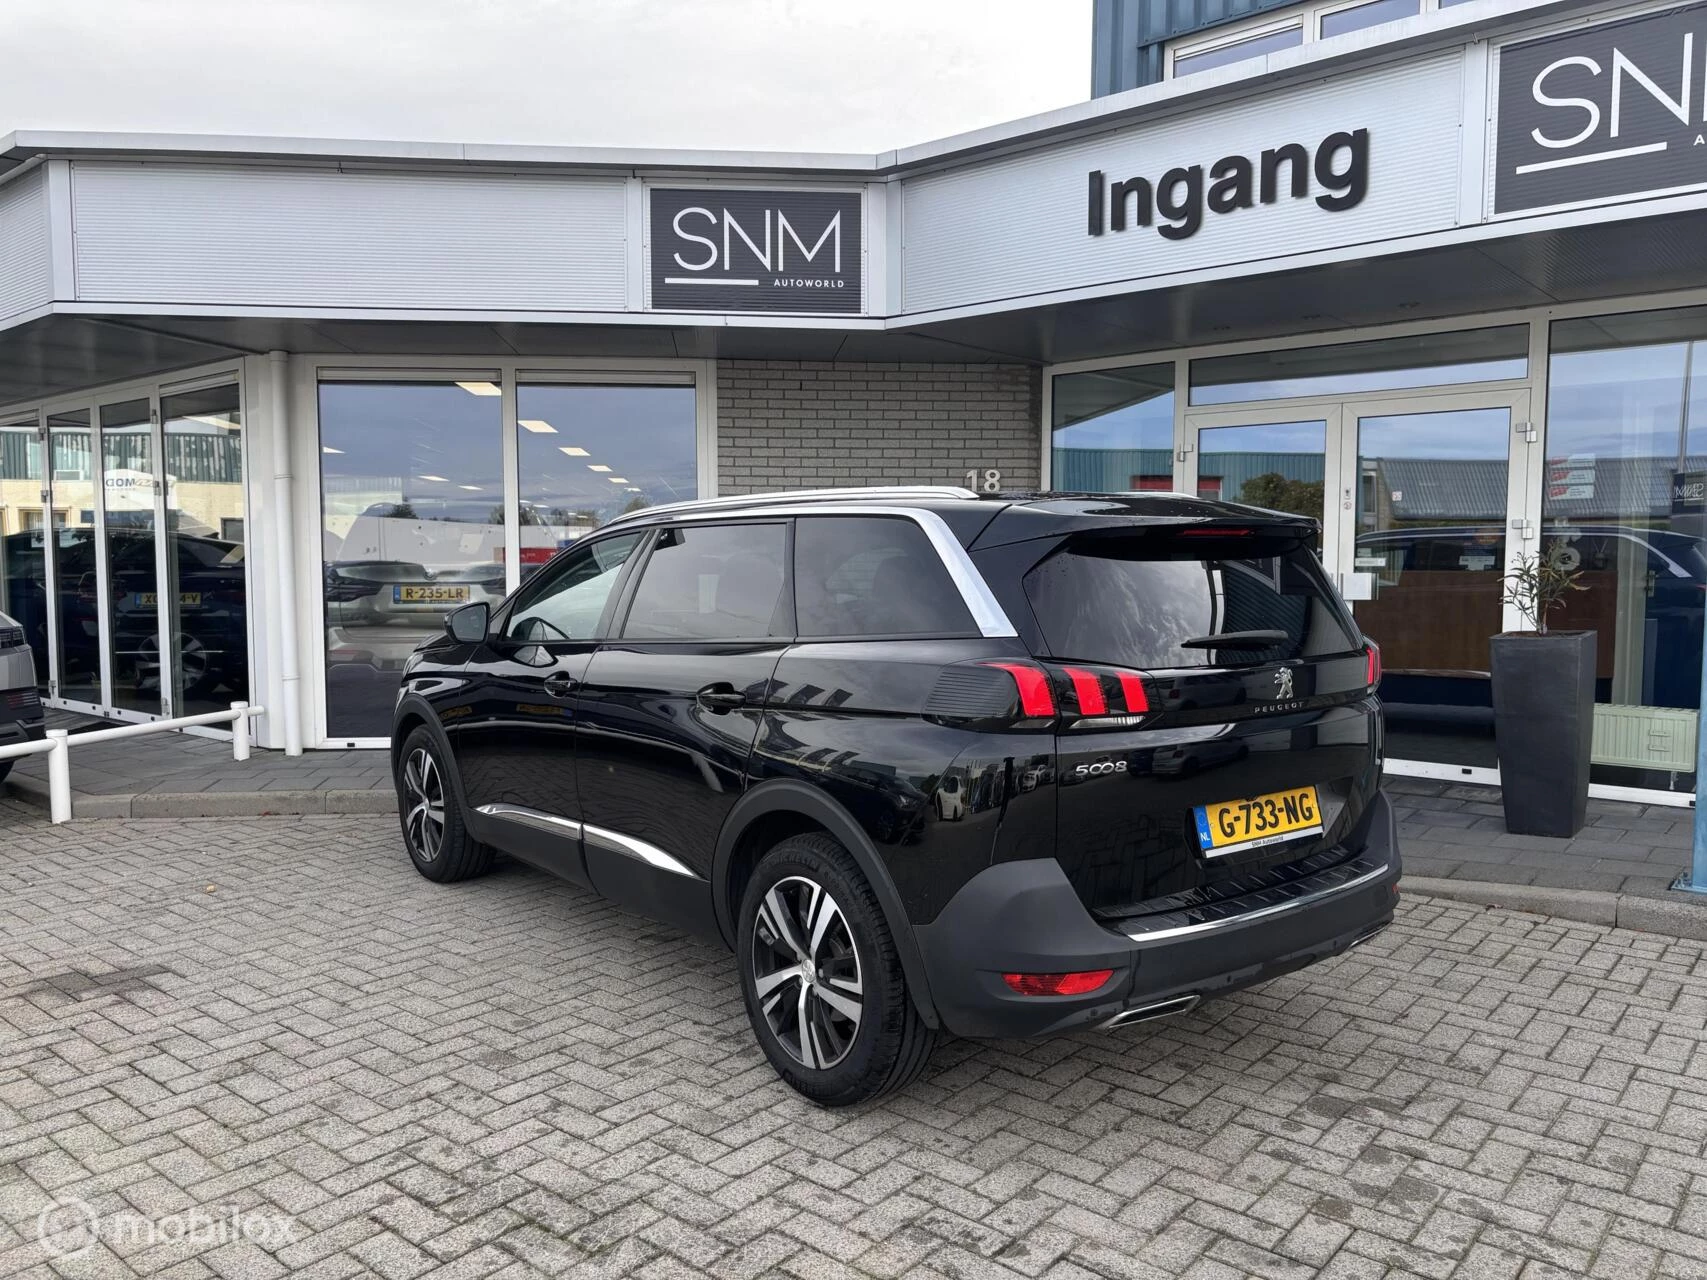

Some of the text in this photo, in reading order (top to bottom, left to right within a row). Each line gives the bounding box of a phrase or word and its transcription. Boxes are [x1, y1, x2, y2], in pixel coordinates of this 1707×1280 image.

[1531, 32, 1707, 148] SN
[1088, 128, 1369, 241] Ingang
[672, 206, 841, 273] SNM
[773, 278, 844, 288] AUTOWORLD
[966, 469, 1000, 492] 18
[406, 587, 464, 599] R-235-LR
[1254, 701, 1304, 714] PEUGEOT
[1075, 760, 1128, 777] 5008
[1218, 793, 1313, 838] G-733-NG
[1200, 832, 1211, 841] NL
